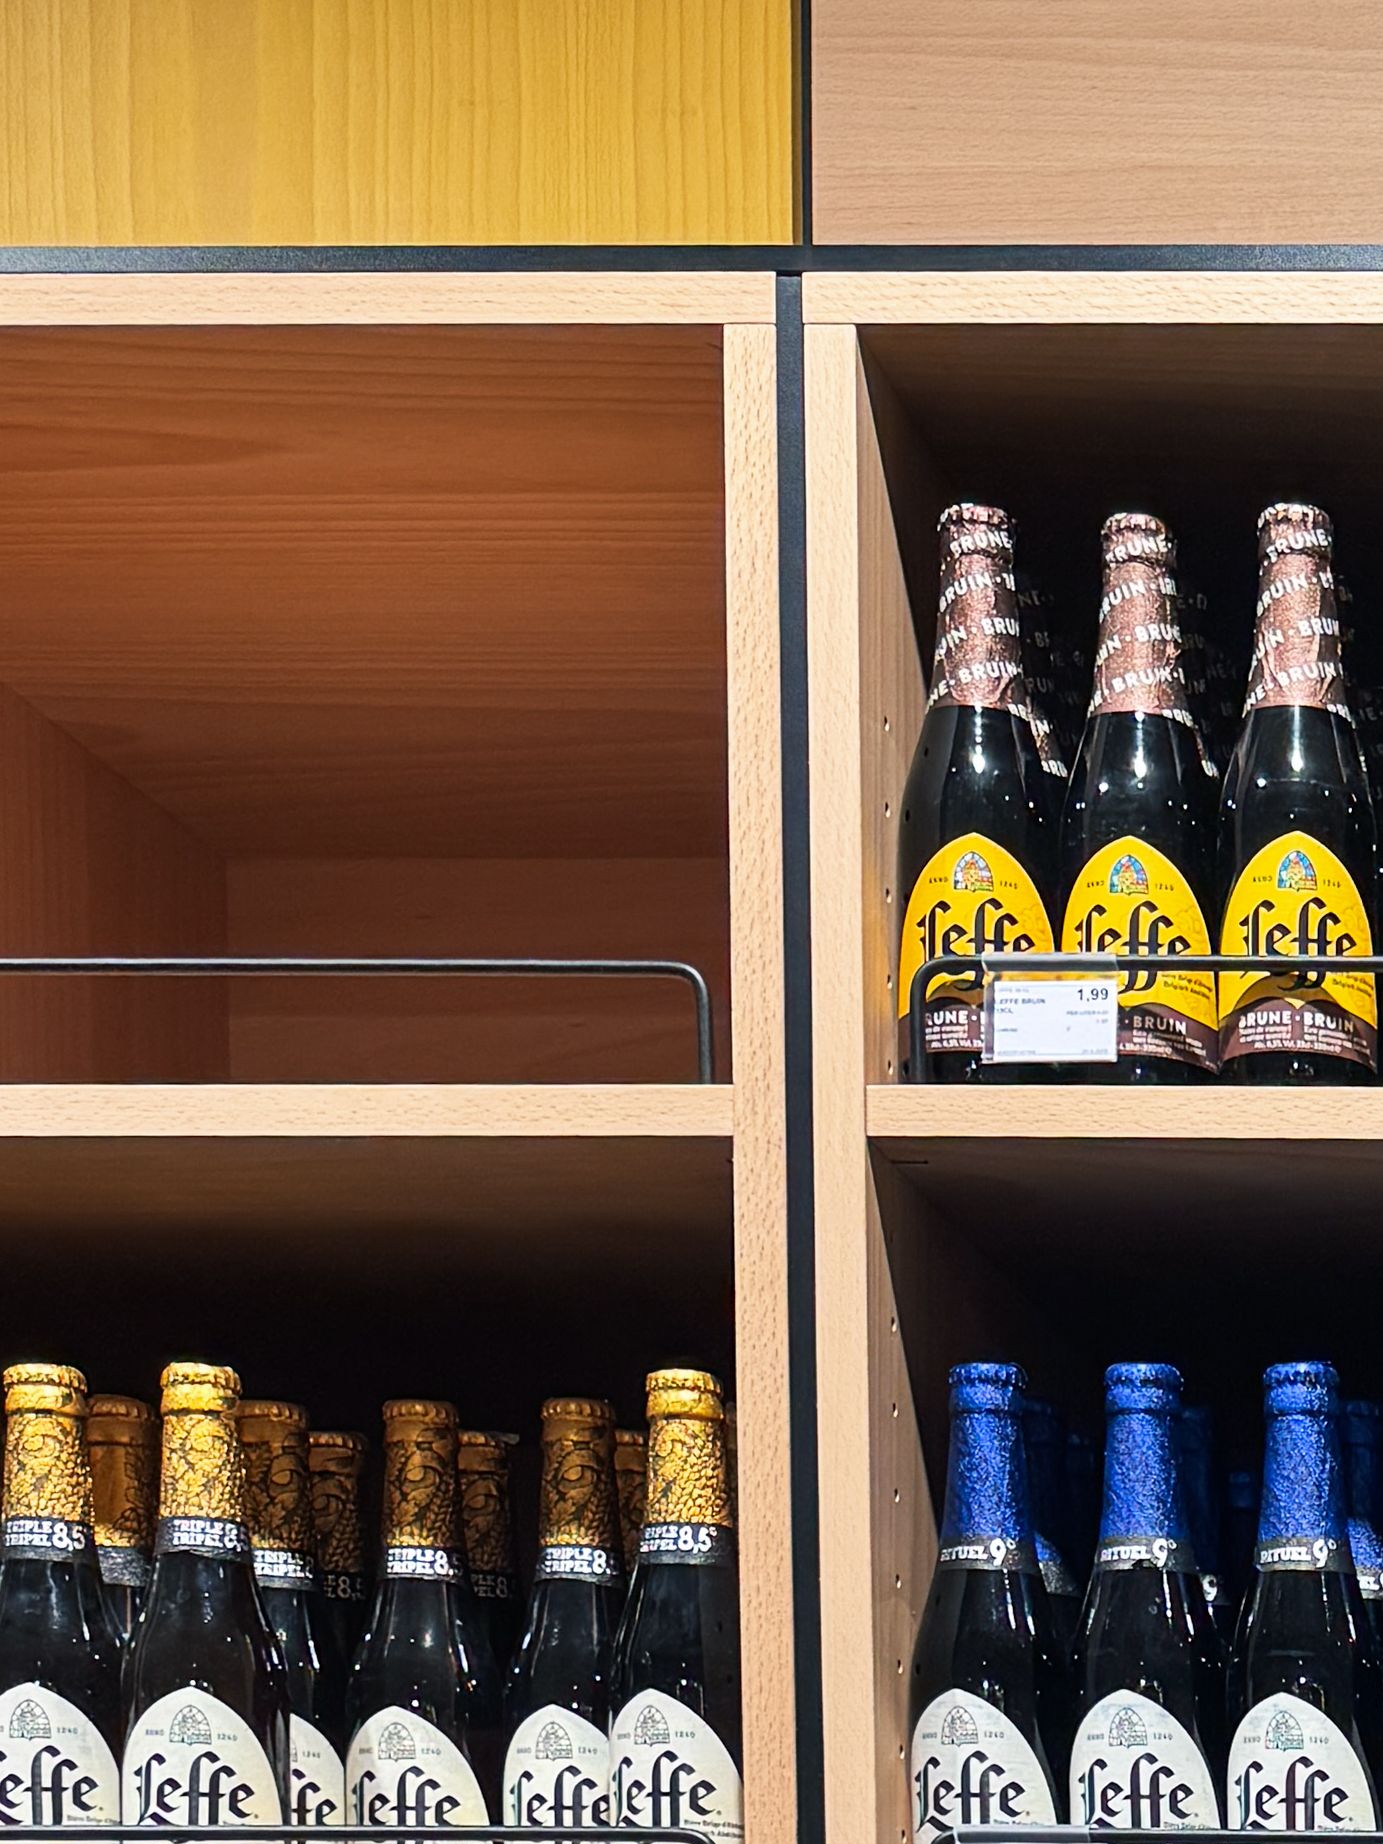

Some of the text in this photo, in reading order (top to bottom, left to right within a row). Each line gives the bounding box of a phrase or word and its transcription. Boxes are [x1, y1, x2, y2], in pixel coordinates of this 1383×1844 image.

[1078, 898, 1191, 992] Leffe
[1245, 896, 1357, 990] Leffe
[1077, 988, 1109, 1003] 1,99
[1303, 1012, 1356, 1034] BRUIN
